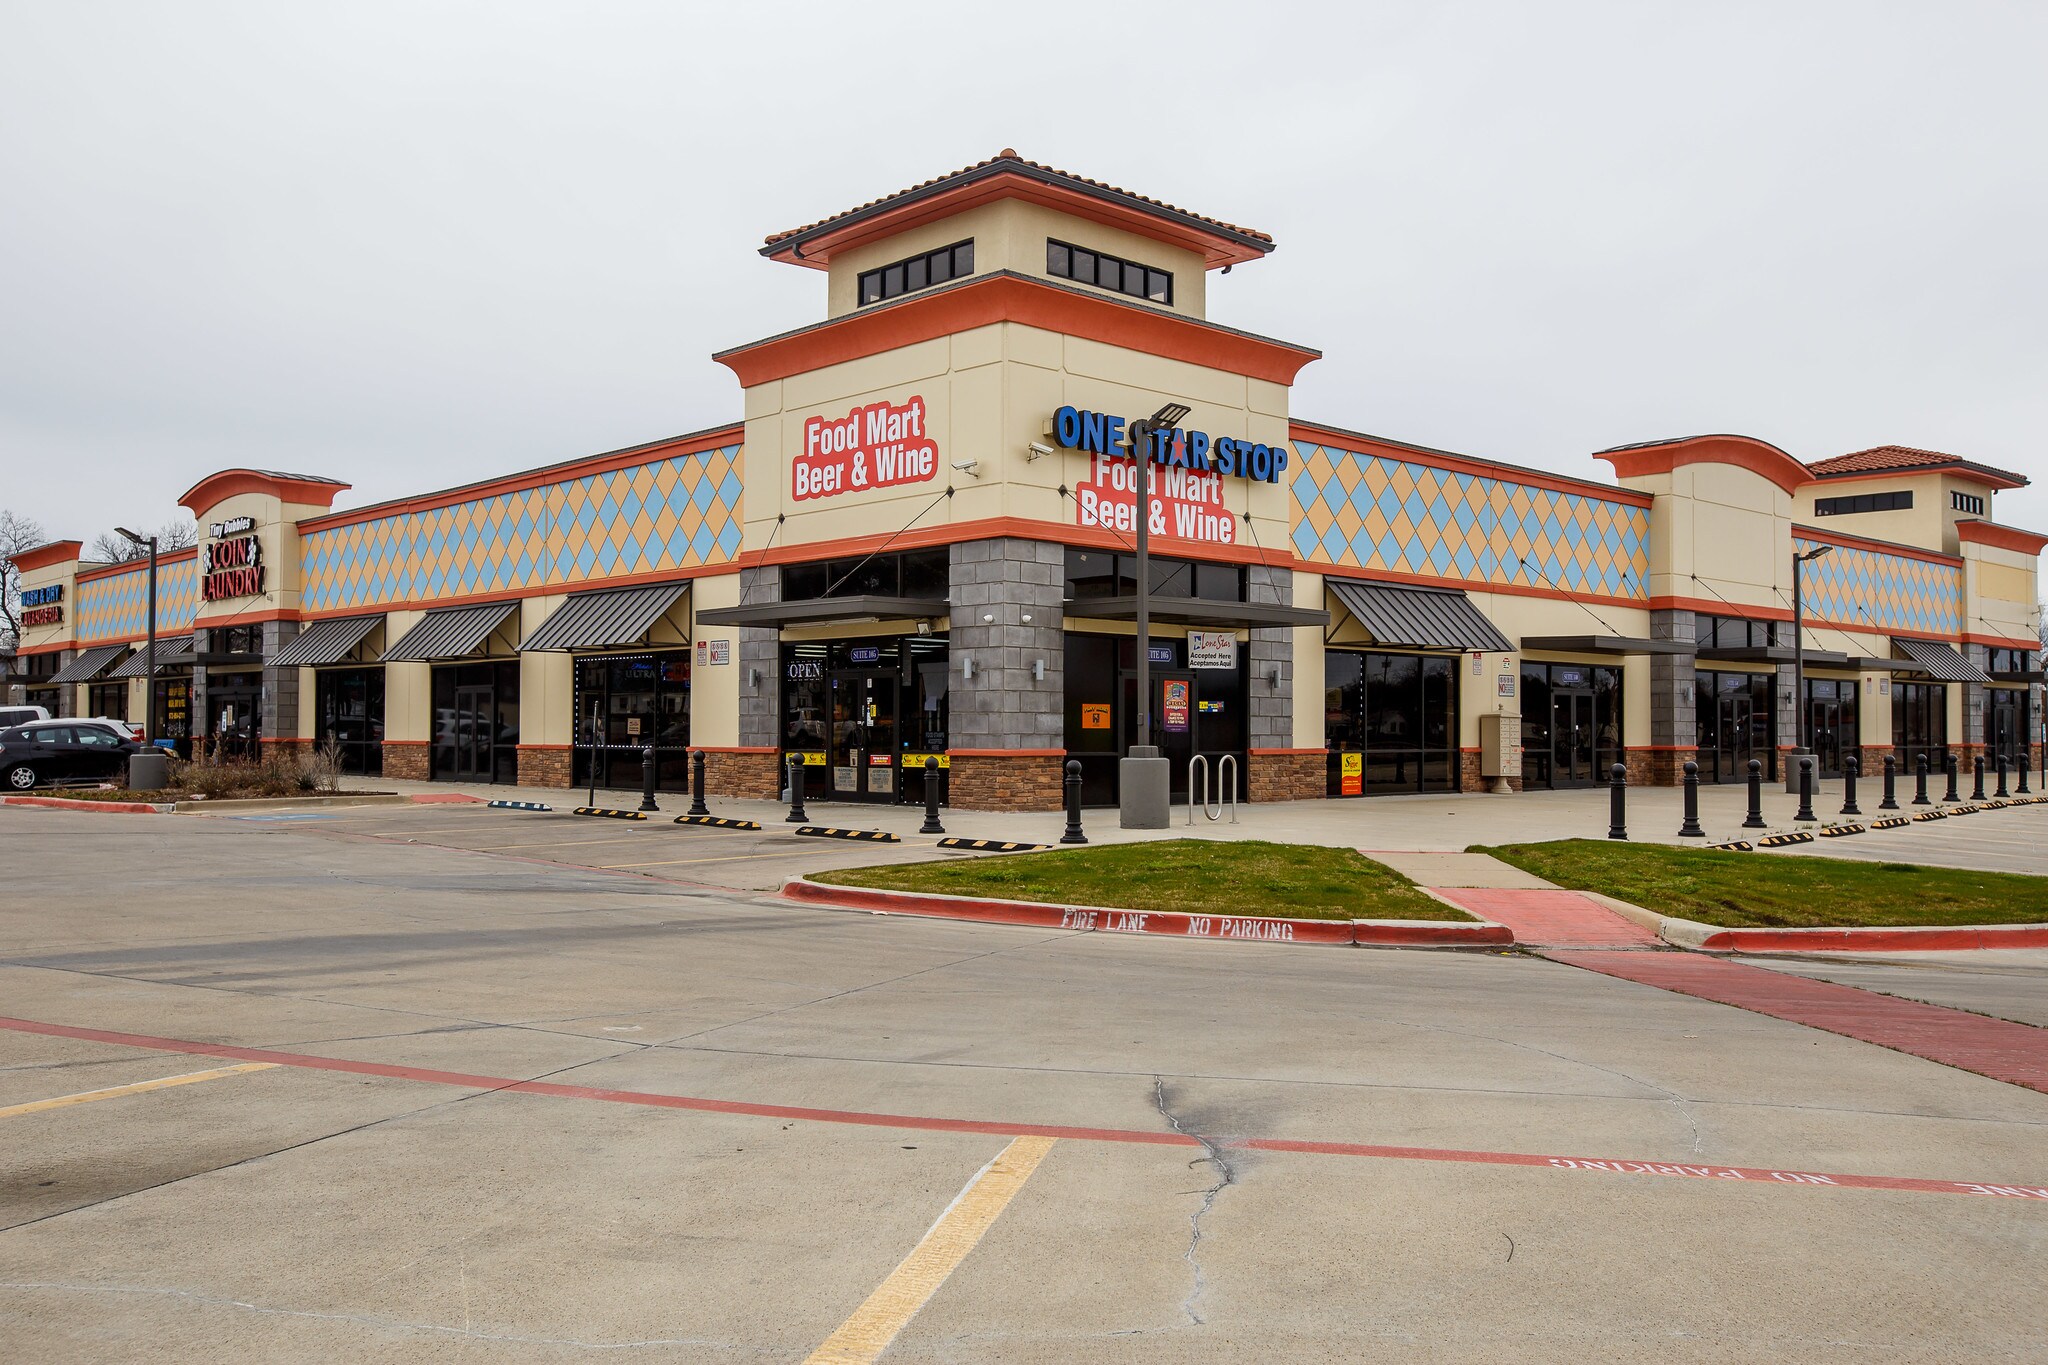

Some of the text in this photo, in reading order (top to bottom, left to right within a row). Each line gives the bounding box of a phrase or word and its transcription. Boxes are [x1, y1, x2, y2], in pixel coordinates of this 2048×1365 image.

[808, 402, 921, 457] Food Mart
[1053, 405, 1125, 457] ONE
[1213, 436, 1288, 484] STOP
[796, 443, 932, 496] Beer & Wine
[1165, 465, 1220, 506] Mart
[224, 517, 251, 535] Bubbles
[1149, 499, 1167, 535] &
[1174, 502, 1232, 544] Wine
[212, 537, 247, 569] COIN
[202, 565, 261, 601] LAUNDRY
[789, 663, 821, 678] OPEN
[853, 650, 868, 659] SUITE
[1147, 650, 1160, 659] ITE
[1190, 652, 1217, 660] Accepted
[1061, 907, 1293, 941] FIRE LANE NO PARKING
[1549, 1158, 1745, 1180] PARKING
